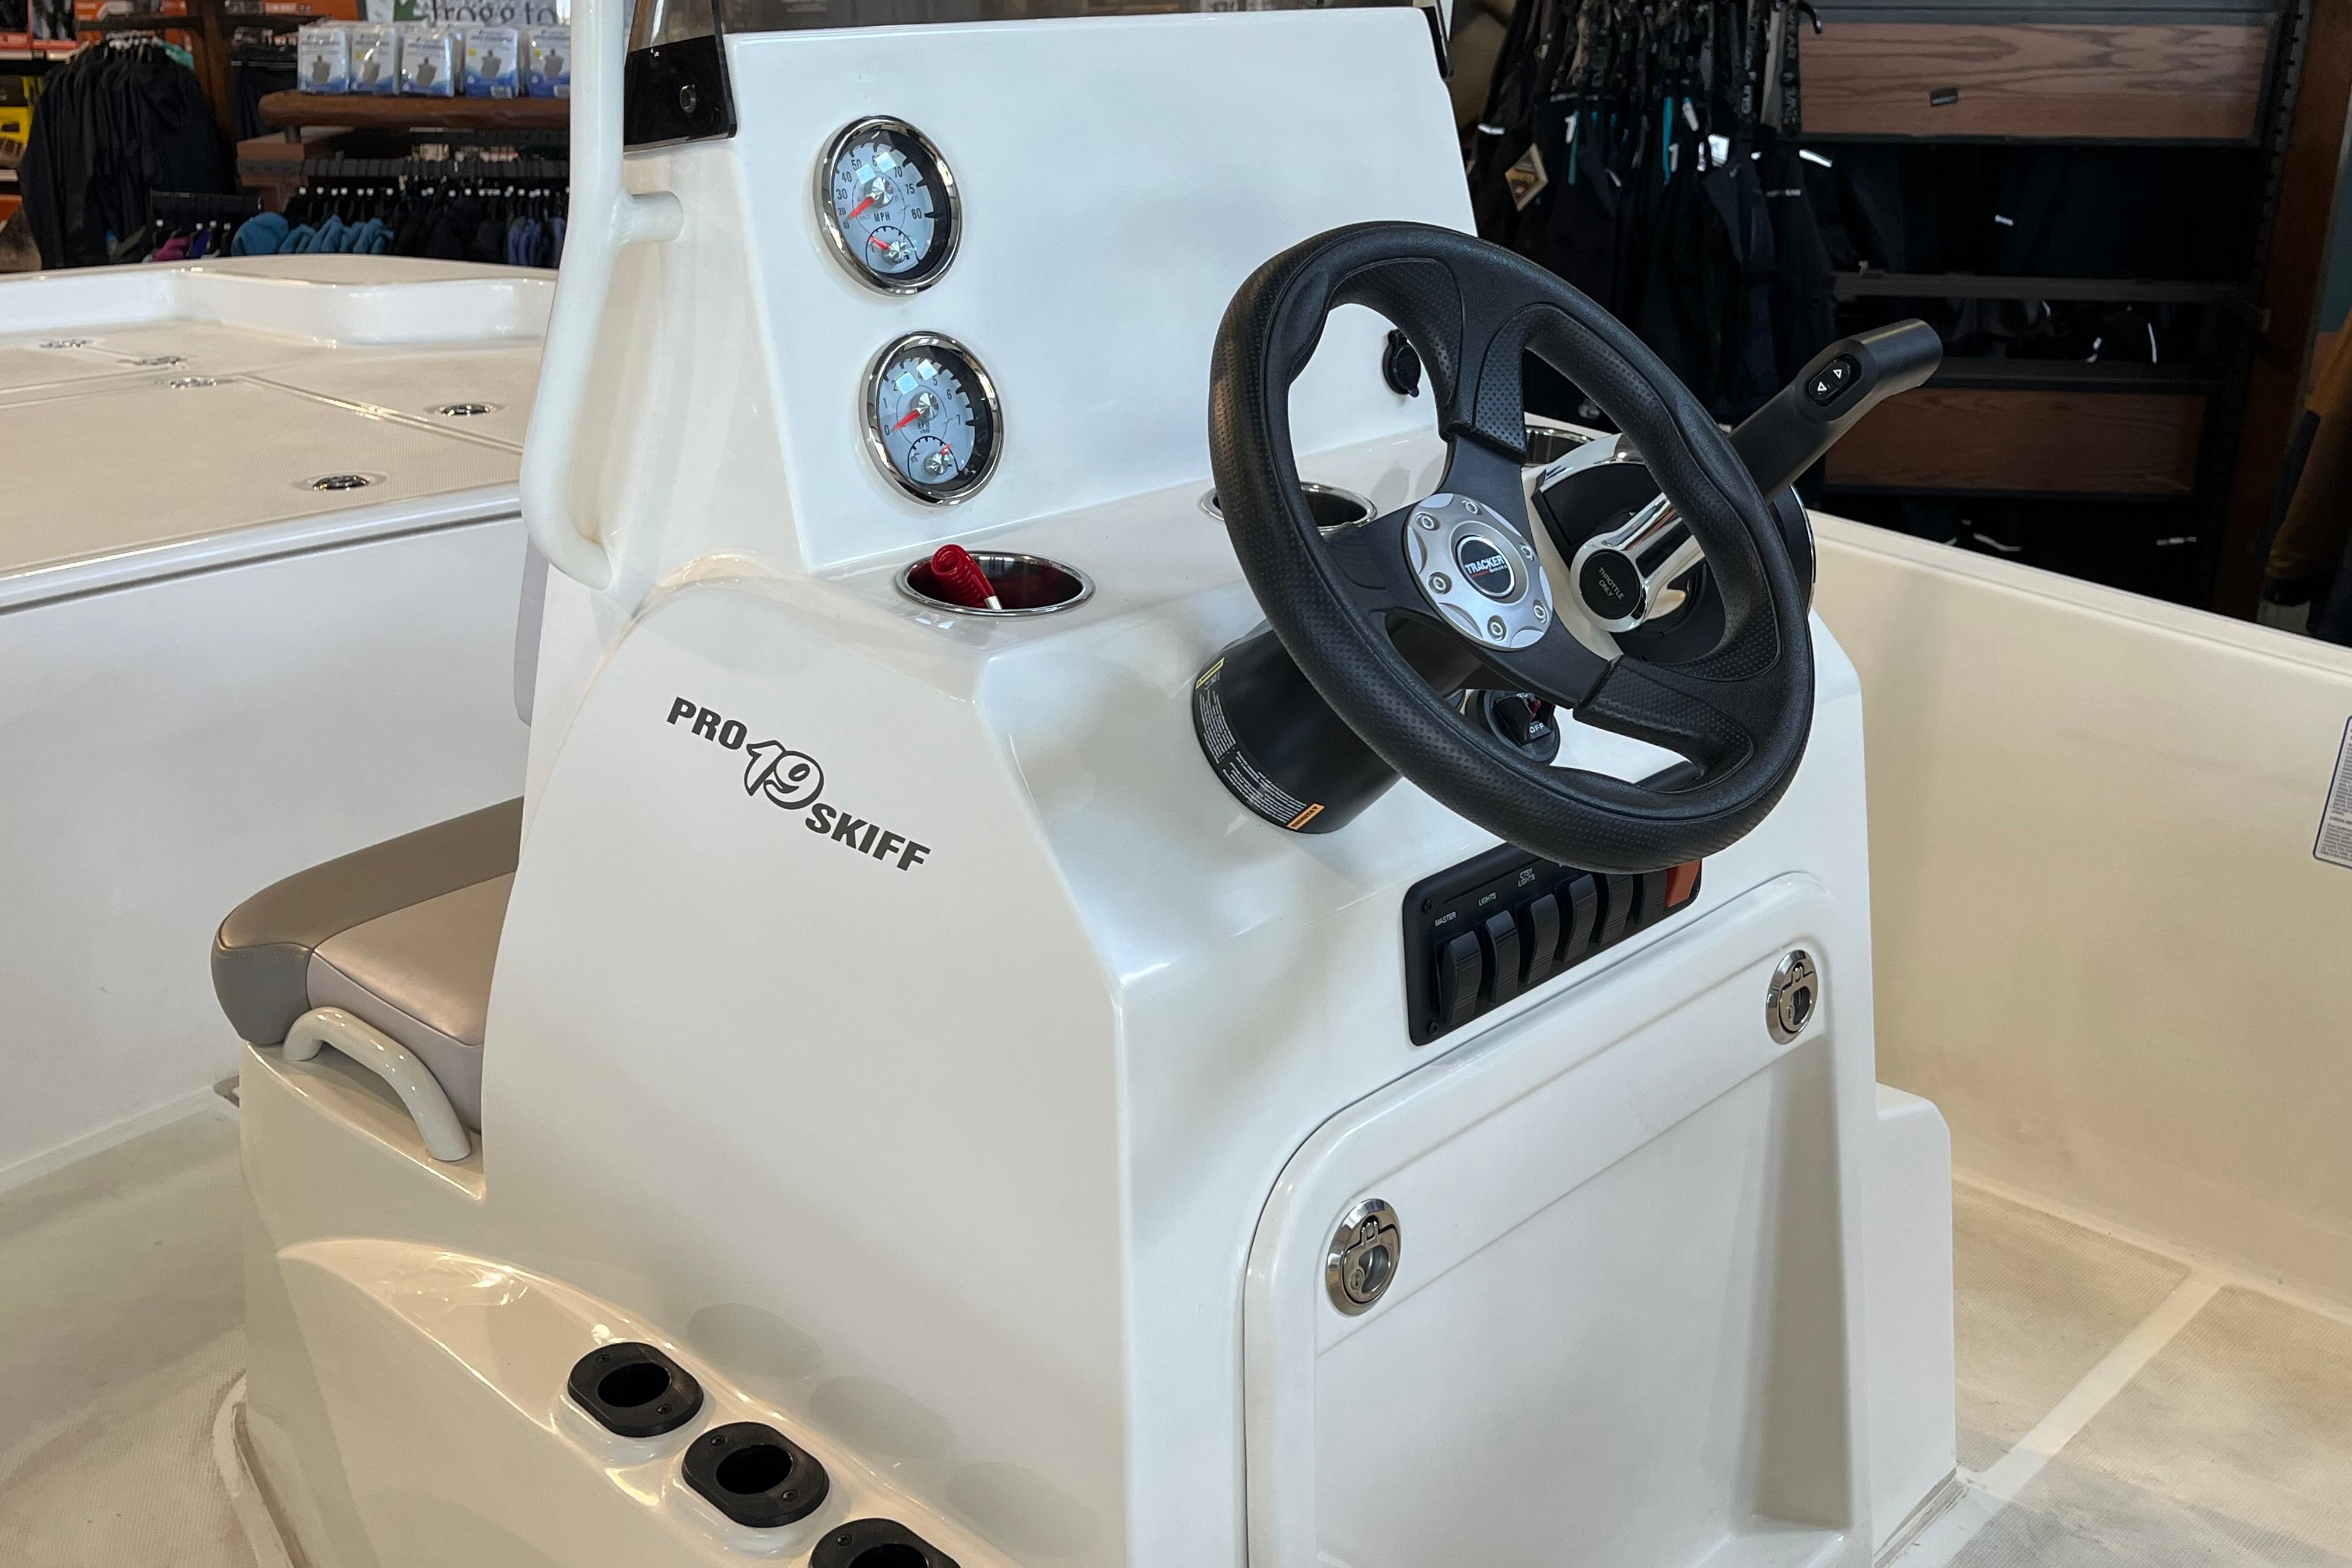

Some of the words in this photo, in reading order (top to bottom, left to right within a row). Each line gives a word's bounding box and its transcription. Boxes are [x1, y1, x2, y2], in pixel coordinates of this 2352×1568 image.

[851, 159, 862, 171] 50
[841, 172, 852, 183] 40
[836, 188, 848, 200] 30
[905, 184, 915, 194] 75
[874, 211, 891, 222] MPH
[911, 208, 922, 219] 80
[891, 380, 898, 391] 2
[947, 388, 953, 400] 6
[883, 397, 888, 409] 1
[884, 424, 890, 436] 0
[1464, 555, 1505, 574] TRACKER
[1598, 580, 1614, 596] ONLY
[1599, 566, 1625, 600] THROTTLE
[1529, 723, 1545, 734] OFF
[666, 696, 748, 750] PRO
[744, 739, 824, 810] 19
[804, 803, 932, 872] SKIFF
[1478, 892, 1497, 907] LIGHTS
[1435, 911, 1457, 927] MASTER
